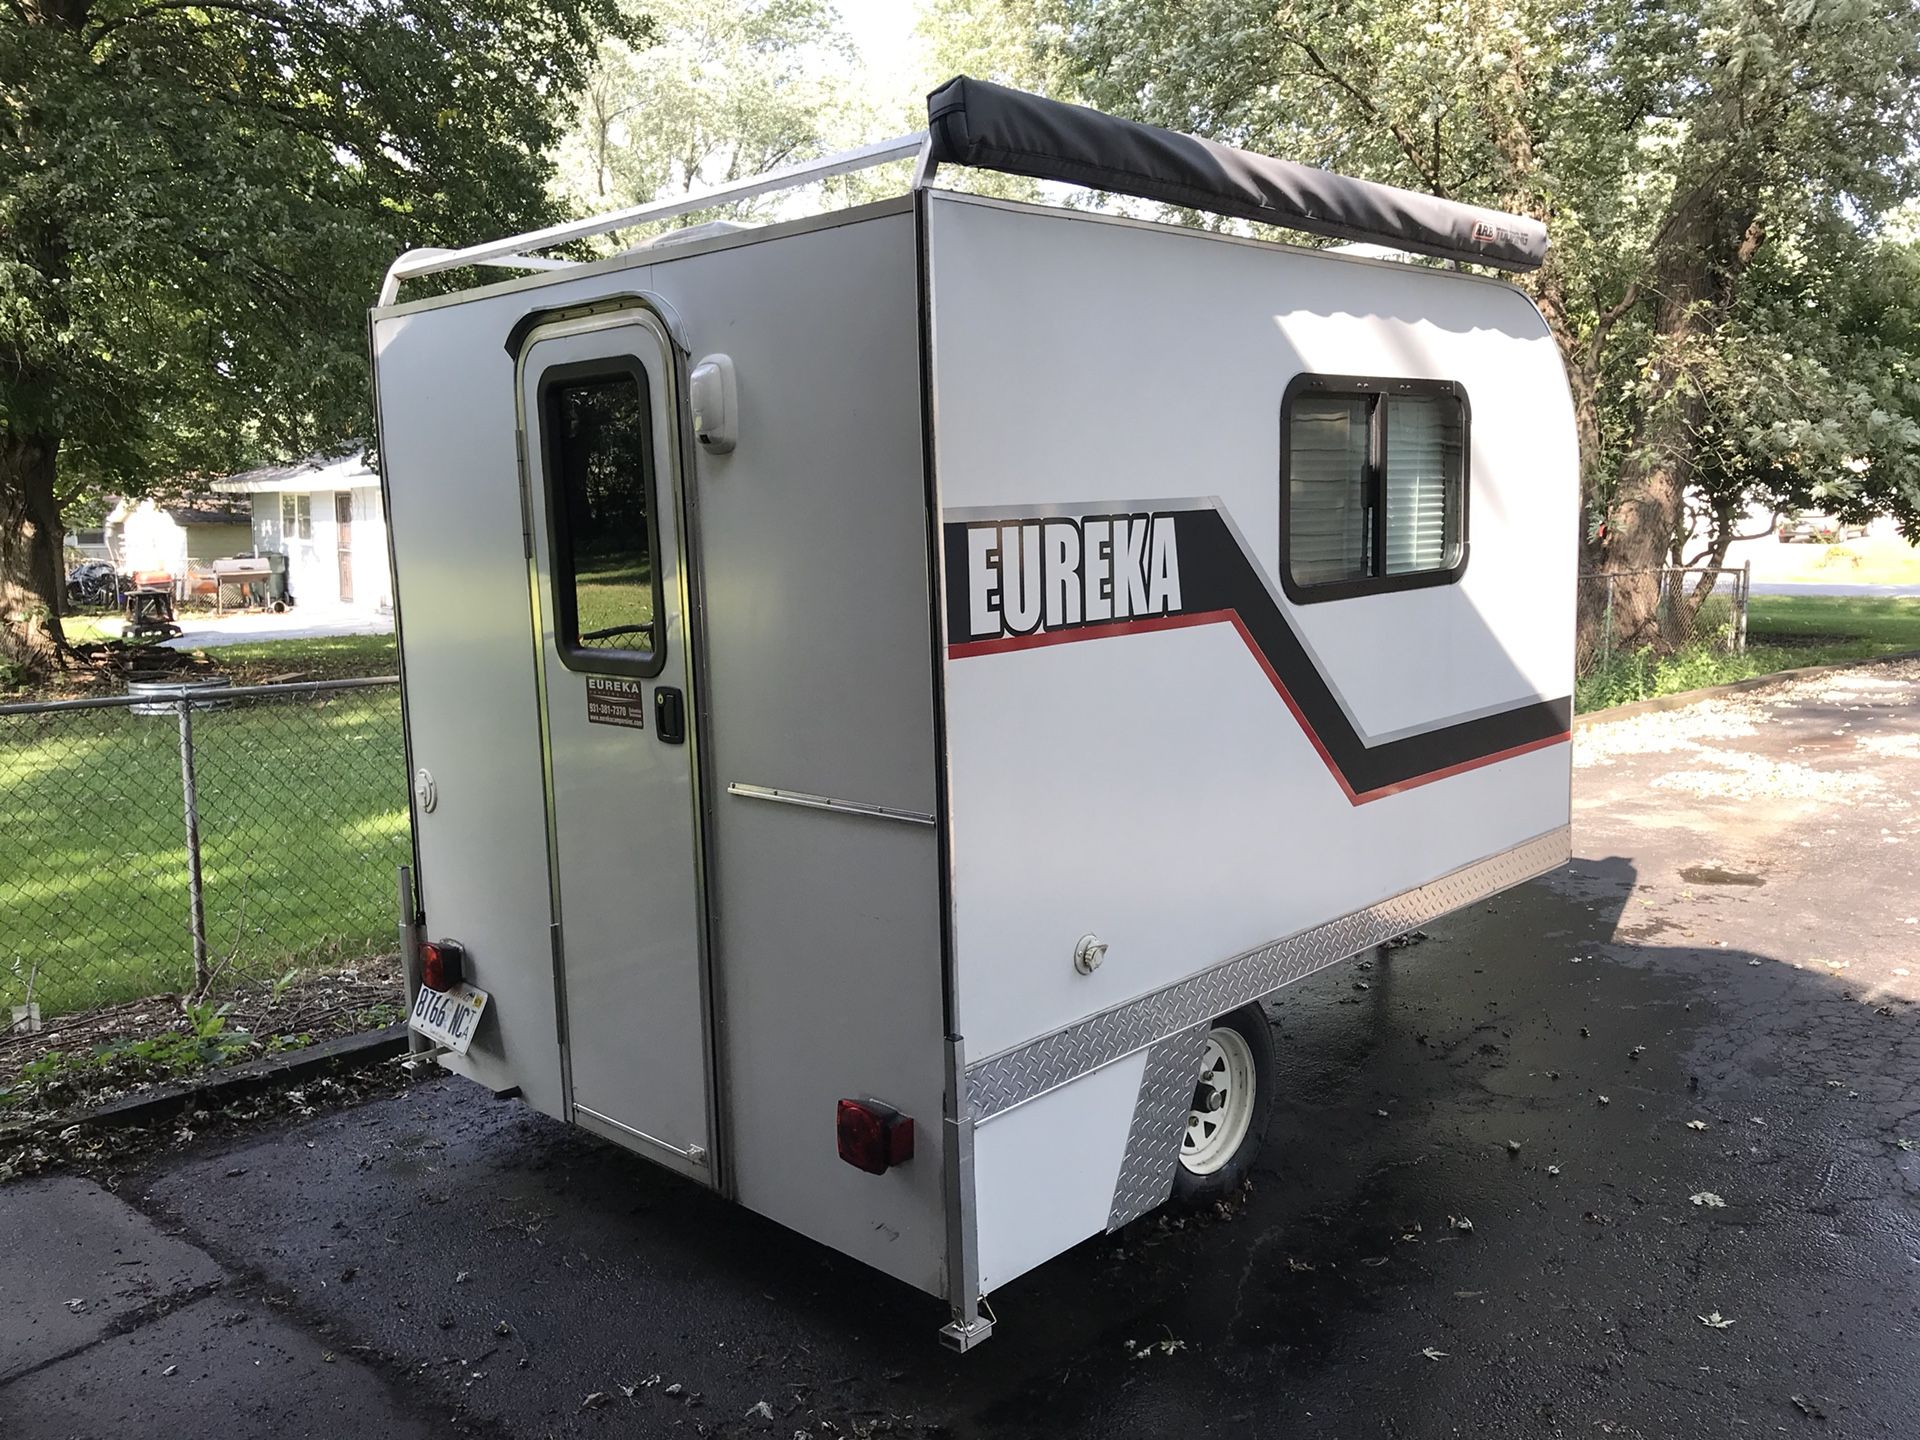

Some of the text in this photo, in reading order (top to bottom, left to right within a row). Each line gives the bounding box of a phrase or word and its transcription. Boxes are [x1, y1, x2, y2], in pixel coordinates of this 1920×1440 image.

[1475, 223, 1494, 238] ARB
[967, 516, 1182, 636] EUREKA
[588, 679, 639, 693] EUREKA
[415, 988, 451, 1027] 8766
[447, 1003, 470, 1039] NC
